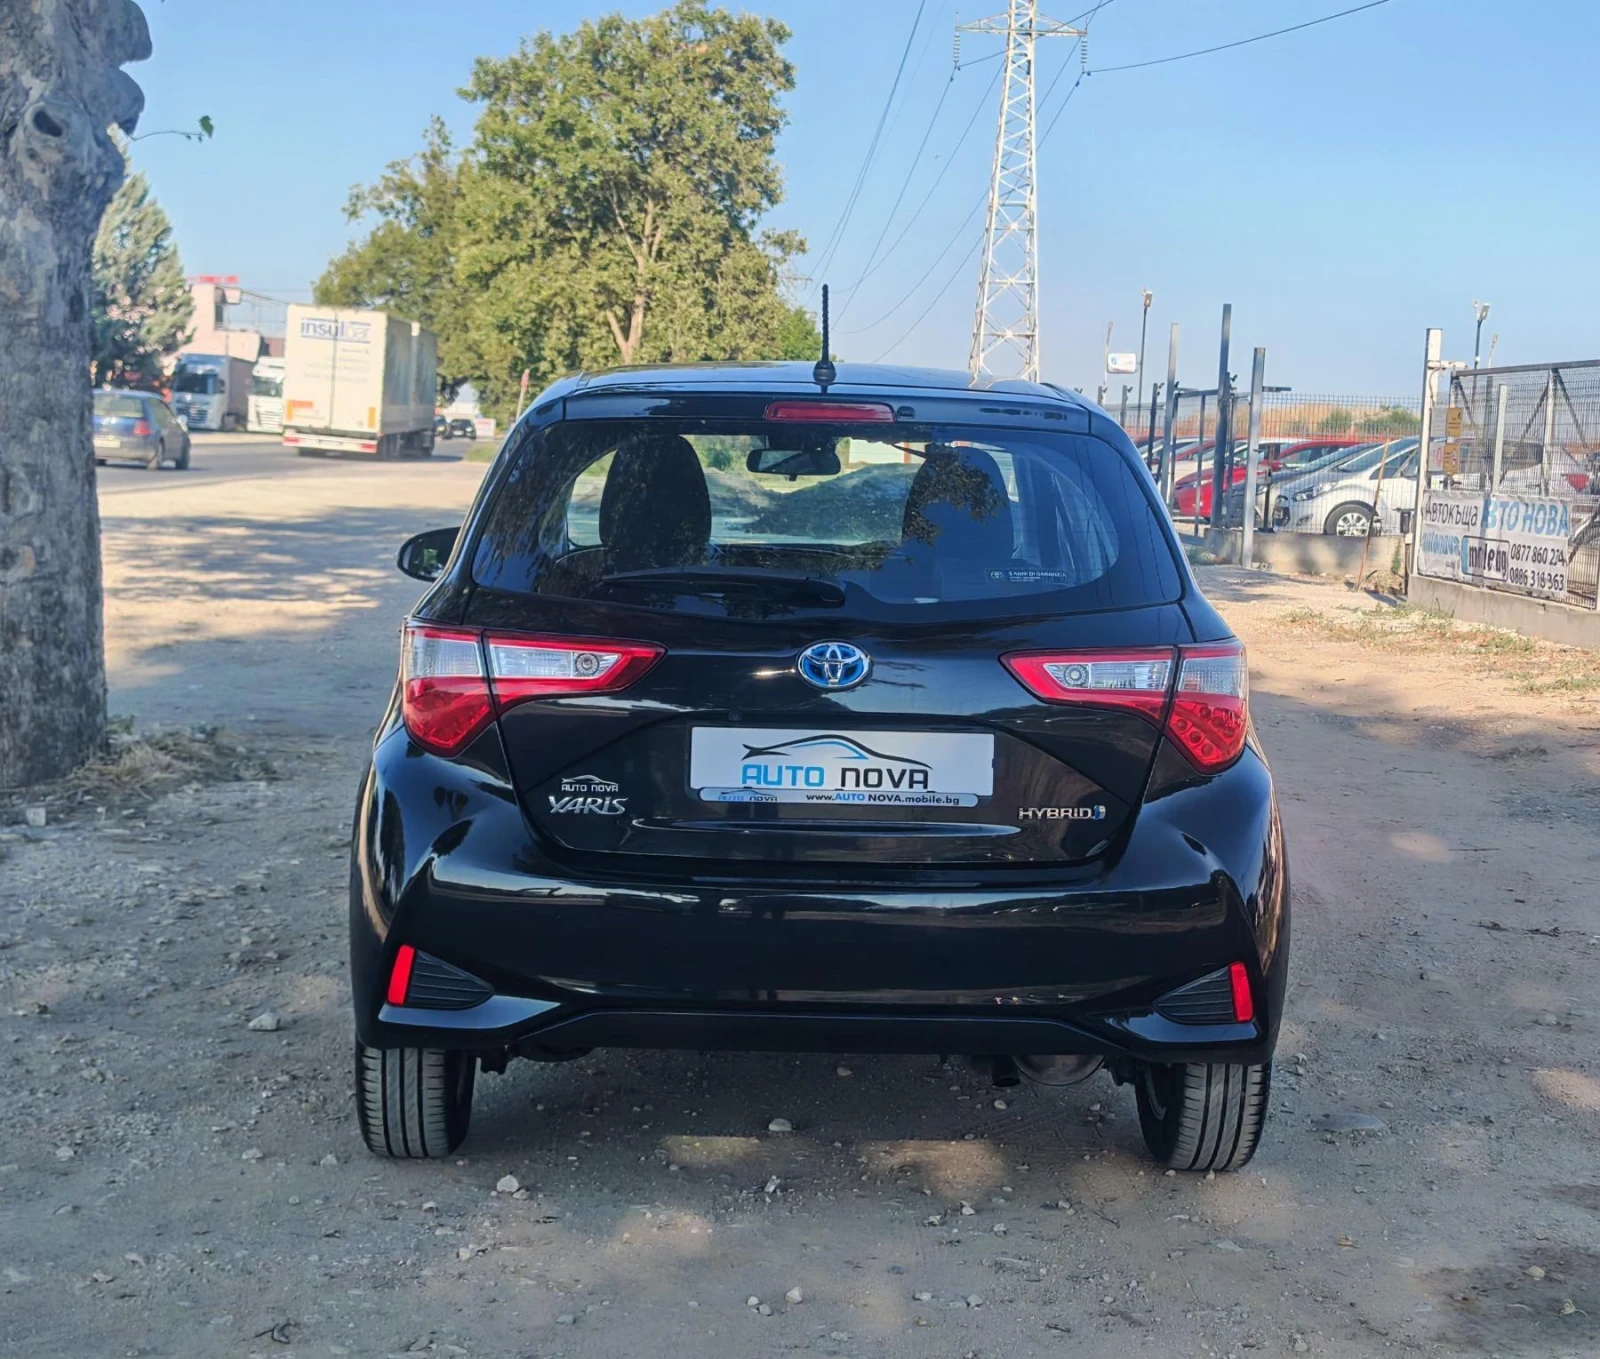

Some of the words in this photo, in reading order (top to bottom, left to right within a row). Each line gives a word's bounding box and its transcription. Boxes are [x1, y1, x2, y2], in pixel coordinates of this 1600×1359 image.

[1522, 501, 1569, 537] НОВА
[1510, 543, 1531, 562] 0877
[1531, 546, 1548, 564] 860
[1530, 570, 1546, 589] 318
[1547, 573, 1565, 591] 363
[741, 763, 824, 787] AUTO
[840, 767, 929, 790] NOVA
[561, 784, 587, 792] AUTO
[591, 784, 619, 792] NOVA
[868, 794, 960, 806] NOVA.mobile.bg
[1018, 807, 1092, 819] HYBRID
